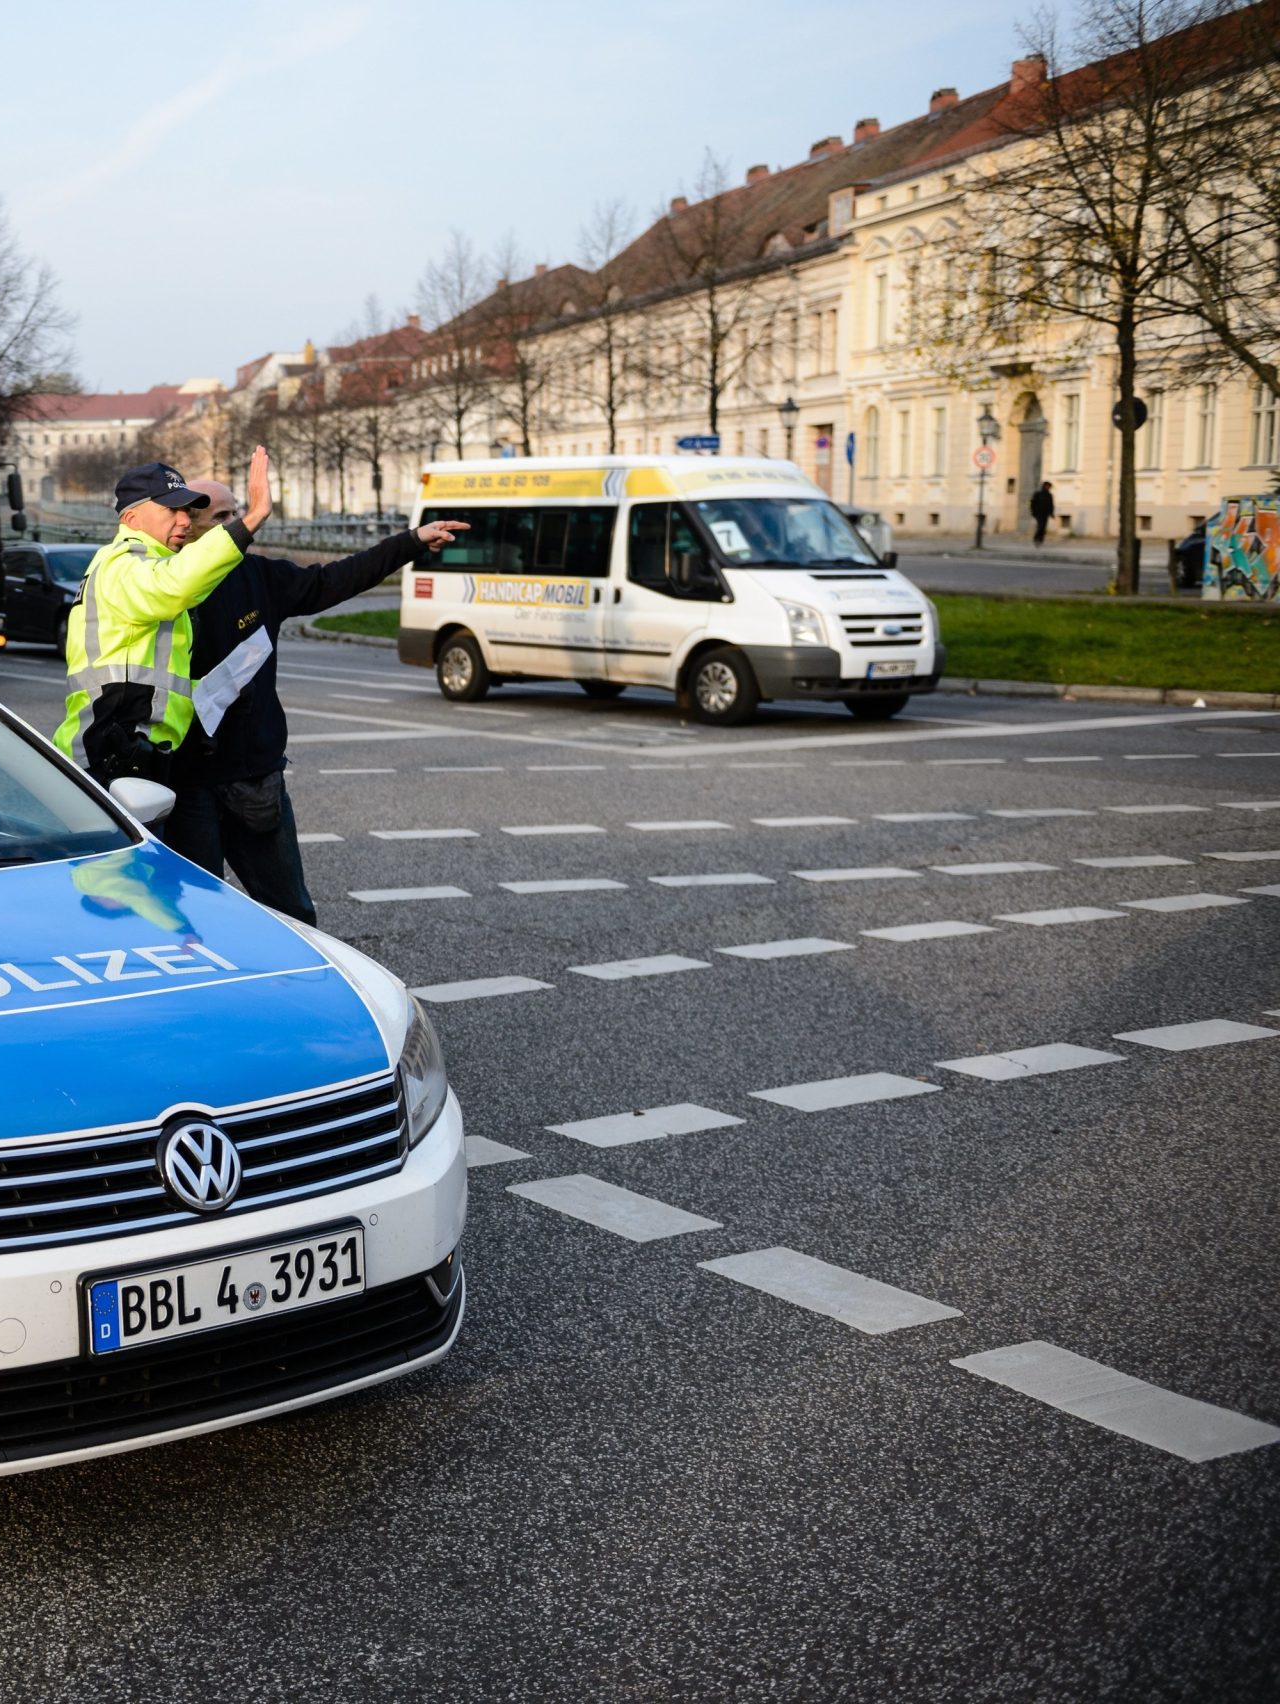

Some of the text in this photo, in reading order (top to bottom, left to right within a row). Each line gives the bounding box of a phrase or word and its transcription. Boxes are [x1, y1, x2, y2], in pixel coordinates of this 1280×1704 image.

[717, 529, 732, 548] 7
[480, 580, 585, 605] HANDICAP MOBIL
[121, 1236, 361, 1336] BBL 4 3931
[101, 1323, 111, 1339] D
